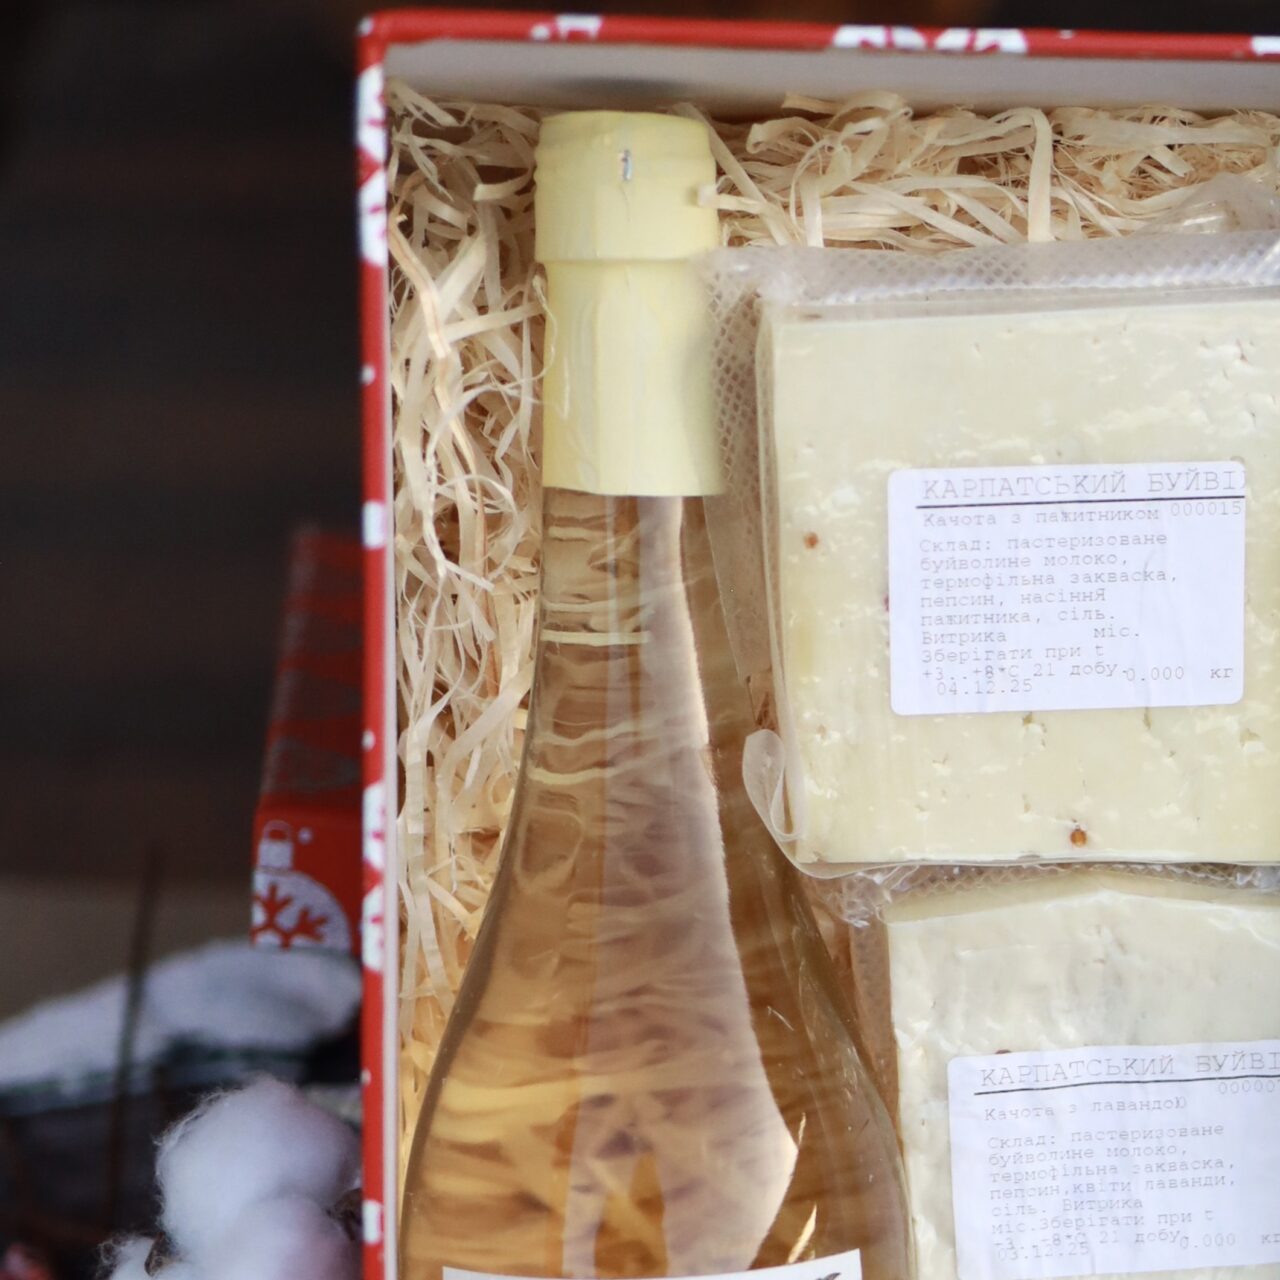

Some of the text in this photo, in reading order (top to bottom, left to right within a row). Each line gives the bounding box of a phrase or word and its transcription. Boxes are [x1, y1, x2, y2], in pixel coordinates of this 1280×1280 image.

[922, 468, 1245, 500] КАРПАТСЬКИЙ БУЙВІ
[923, 509, 1159, 527] Качота з пажитником
[919, 534, 1168, 553] Склад: пастеризоване
[920, 554, 1127, 574] буйволине молоко,
[920, 570, 1176, 591] термофільна закваска,
[920, 595, 1004, 608] пепсин,
[920, 607, 1115, 627] пажитника, сіль.
[922, 626, 1139, 646] Витрика міс.
[922, 647, 1033, 664] Зберігати
[1045, 647, 1081, 661] при
[1033, 663, 1056, 677] 21
[1209, 668, 1234, 679] кг
[936, 678, 1033, 696] 04.12.25
[980, 1054, 1174, 1087] КАРПАТСЬКИЙ
[984, 1107, 1055, 1122] Качота
[1068, 1104, 1077, 1114] з
[988, 1124, 1224, 1149] Склад: пастеризоване
[988, 1145, 1187, 1168] буйволине молоко,
[1144, 1175, 1235, 1190] лаванди,
[991, 1198, 1143, 1217] сіль. Витрика
[1157, 1212, 1193, 1226] при
